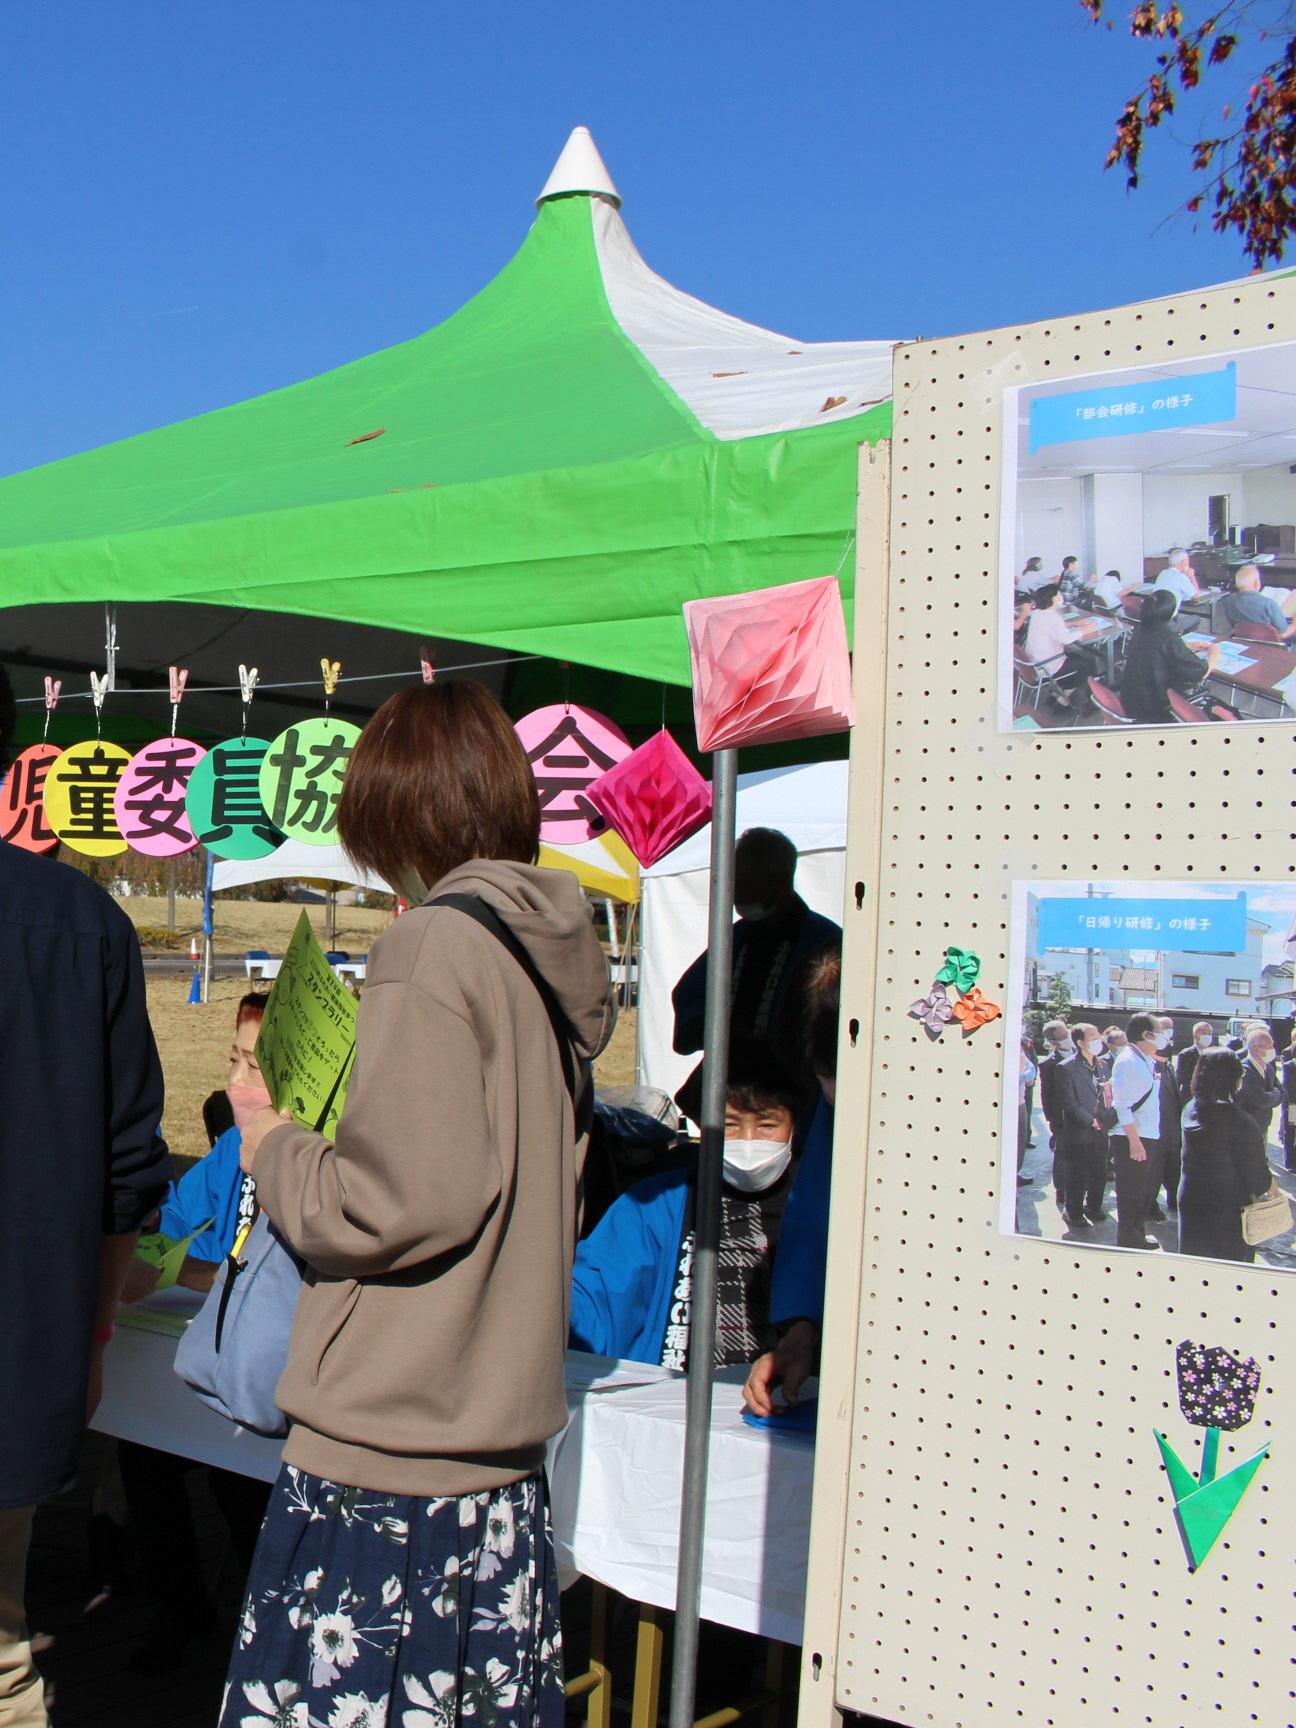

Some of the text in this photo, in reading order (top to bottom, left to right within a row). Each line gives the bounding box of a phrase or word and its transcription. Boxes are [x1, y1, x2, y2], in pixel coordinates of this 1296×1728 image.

[1074, 393, 1194, 421] 「部会研修」の様子
[1078, 915, 1212, 931] 「日帰り研修」の様子
